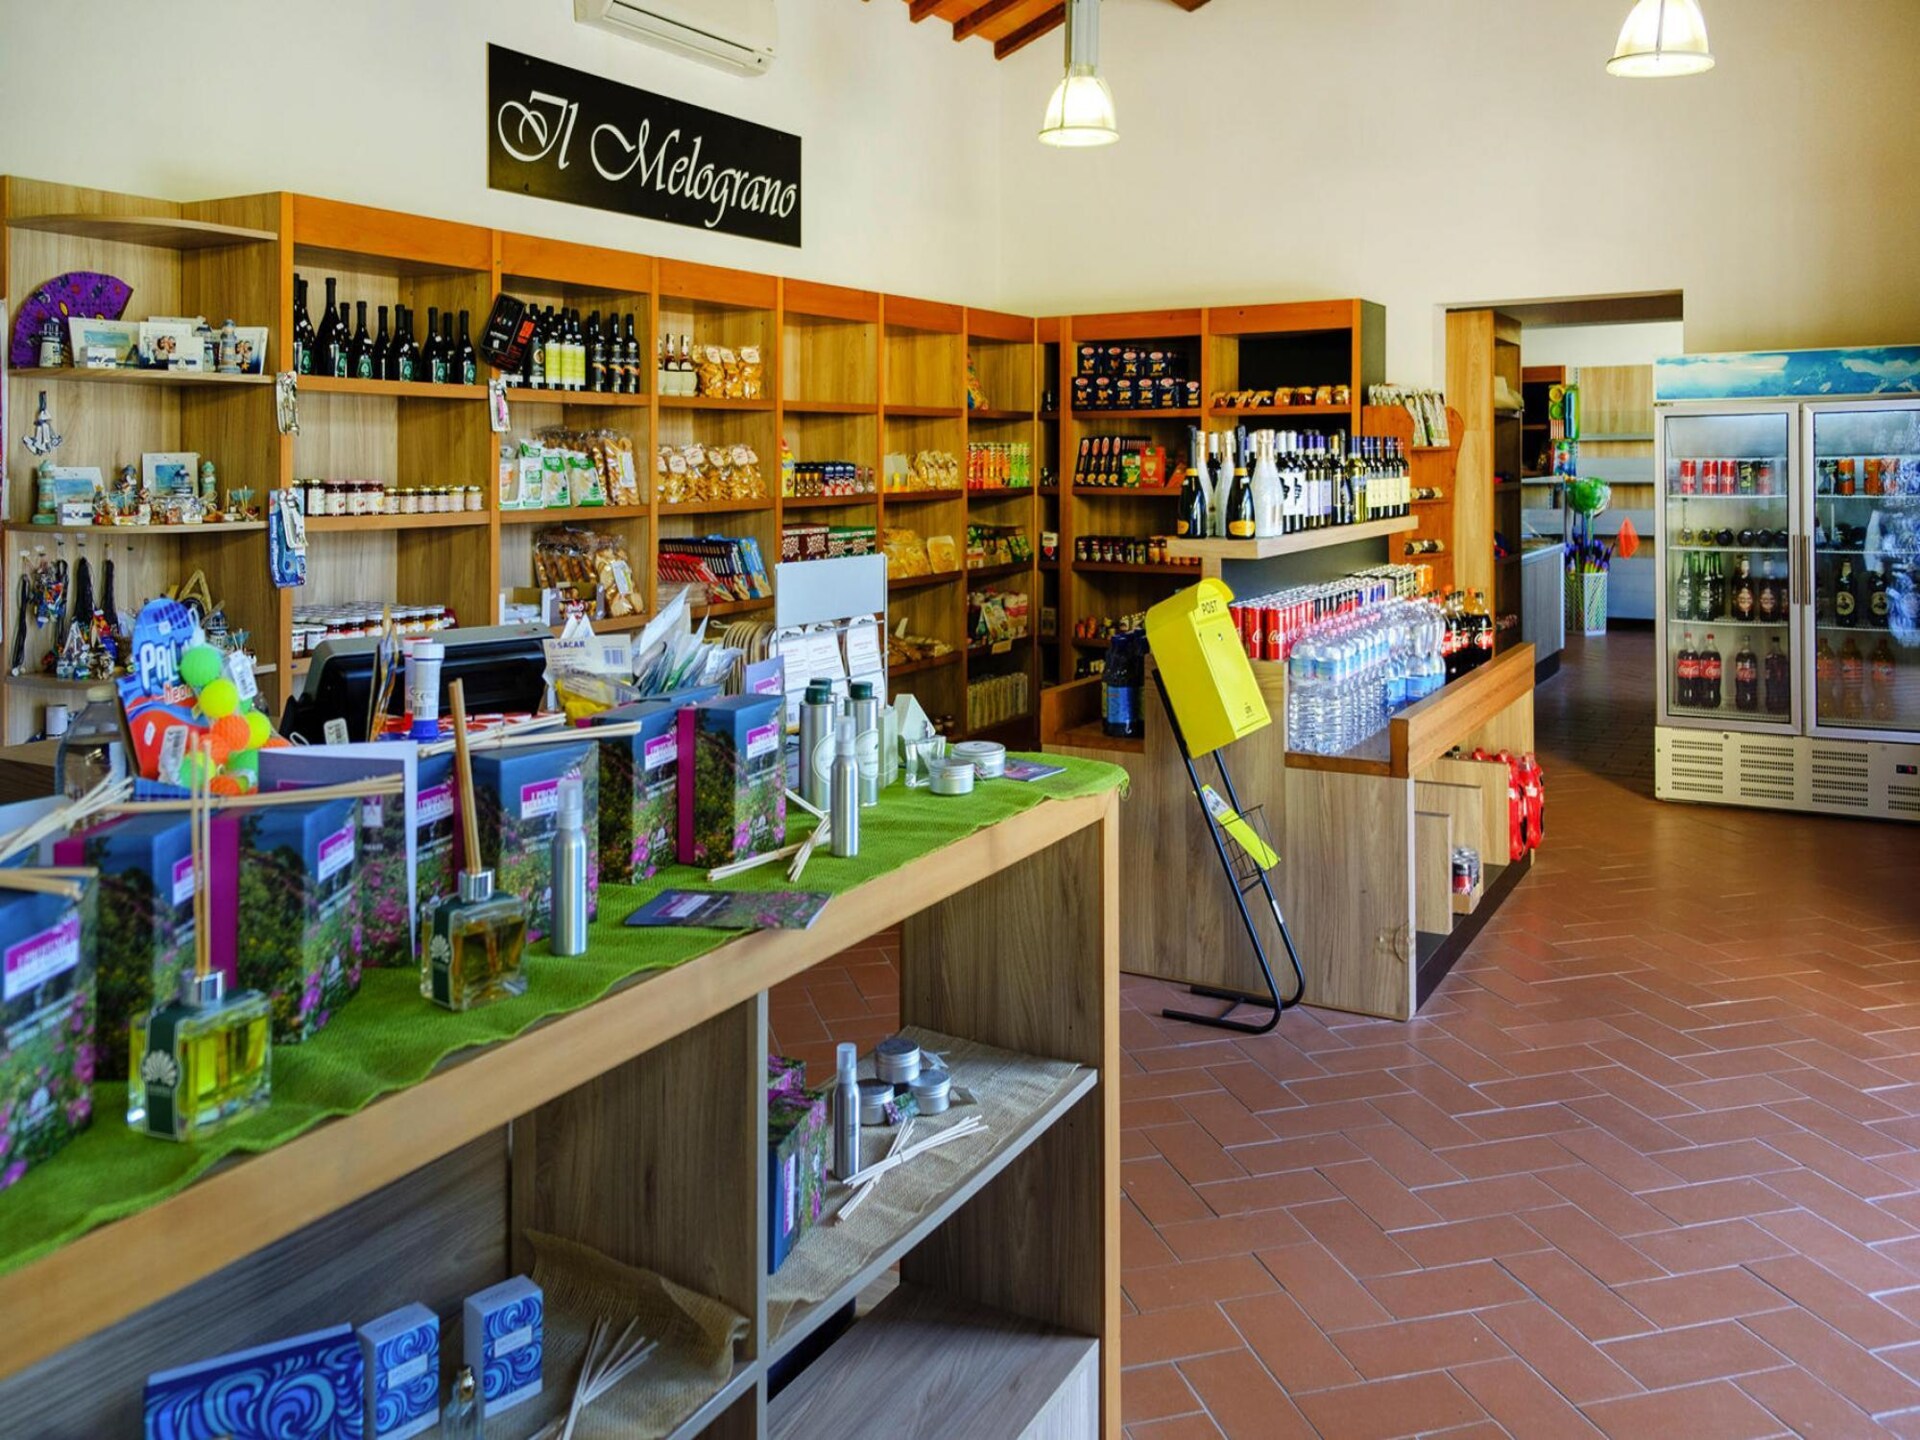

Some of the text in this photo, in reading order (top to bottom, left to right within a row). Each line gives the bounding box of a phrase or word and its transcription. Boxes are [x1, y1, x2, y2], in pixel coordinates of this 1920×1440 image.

[497, 90, 798, 228] Il Melograno
[1201, 600, 1218, 615] POST
[557, 640, 585, 649] SACAR
